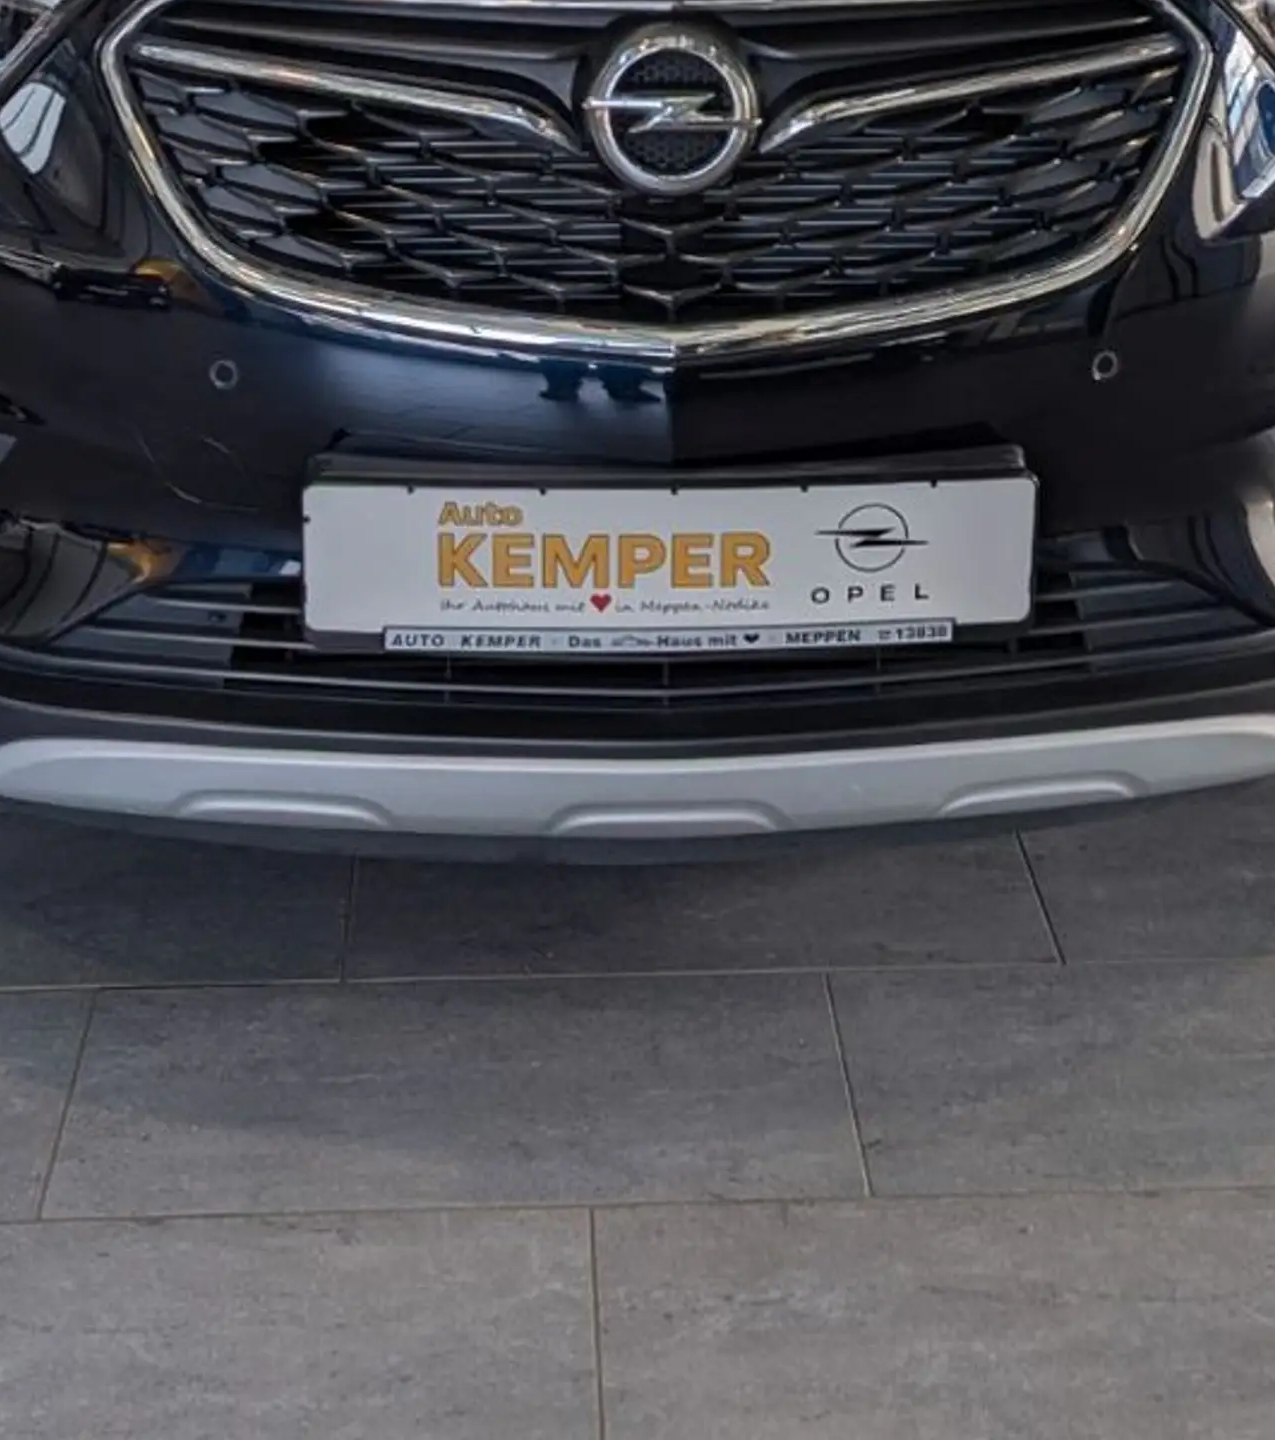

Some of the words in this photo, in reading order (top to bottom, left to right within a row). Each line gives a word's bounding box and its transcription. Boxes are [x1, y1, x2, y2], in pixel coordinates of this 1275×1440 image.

[437, 500, 524, 527] Auto
[436, 531, 772, 589] KEMPER
[811, 583, 930, 605] OPEL
[391, 633, 445, 647] AUTO
[460, 634, 542, 648] KEMPER
[568, 635, 602, 648] Das
[708, 632, 737, 647] mit
[785, 628, 861, 645] MEPPEN
